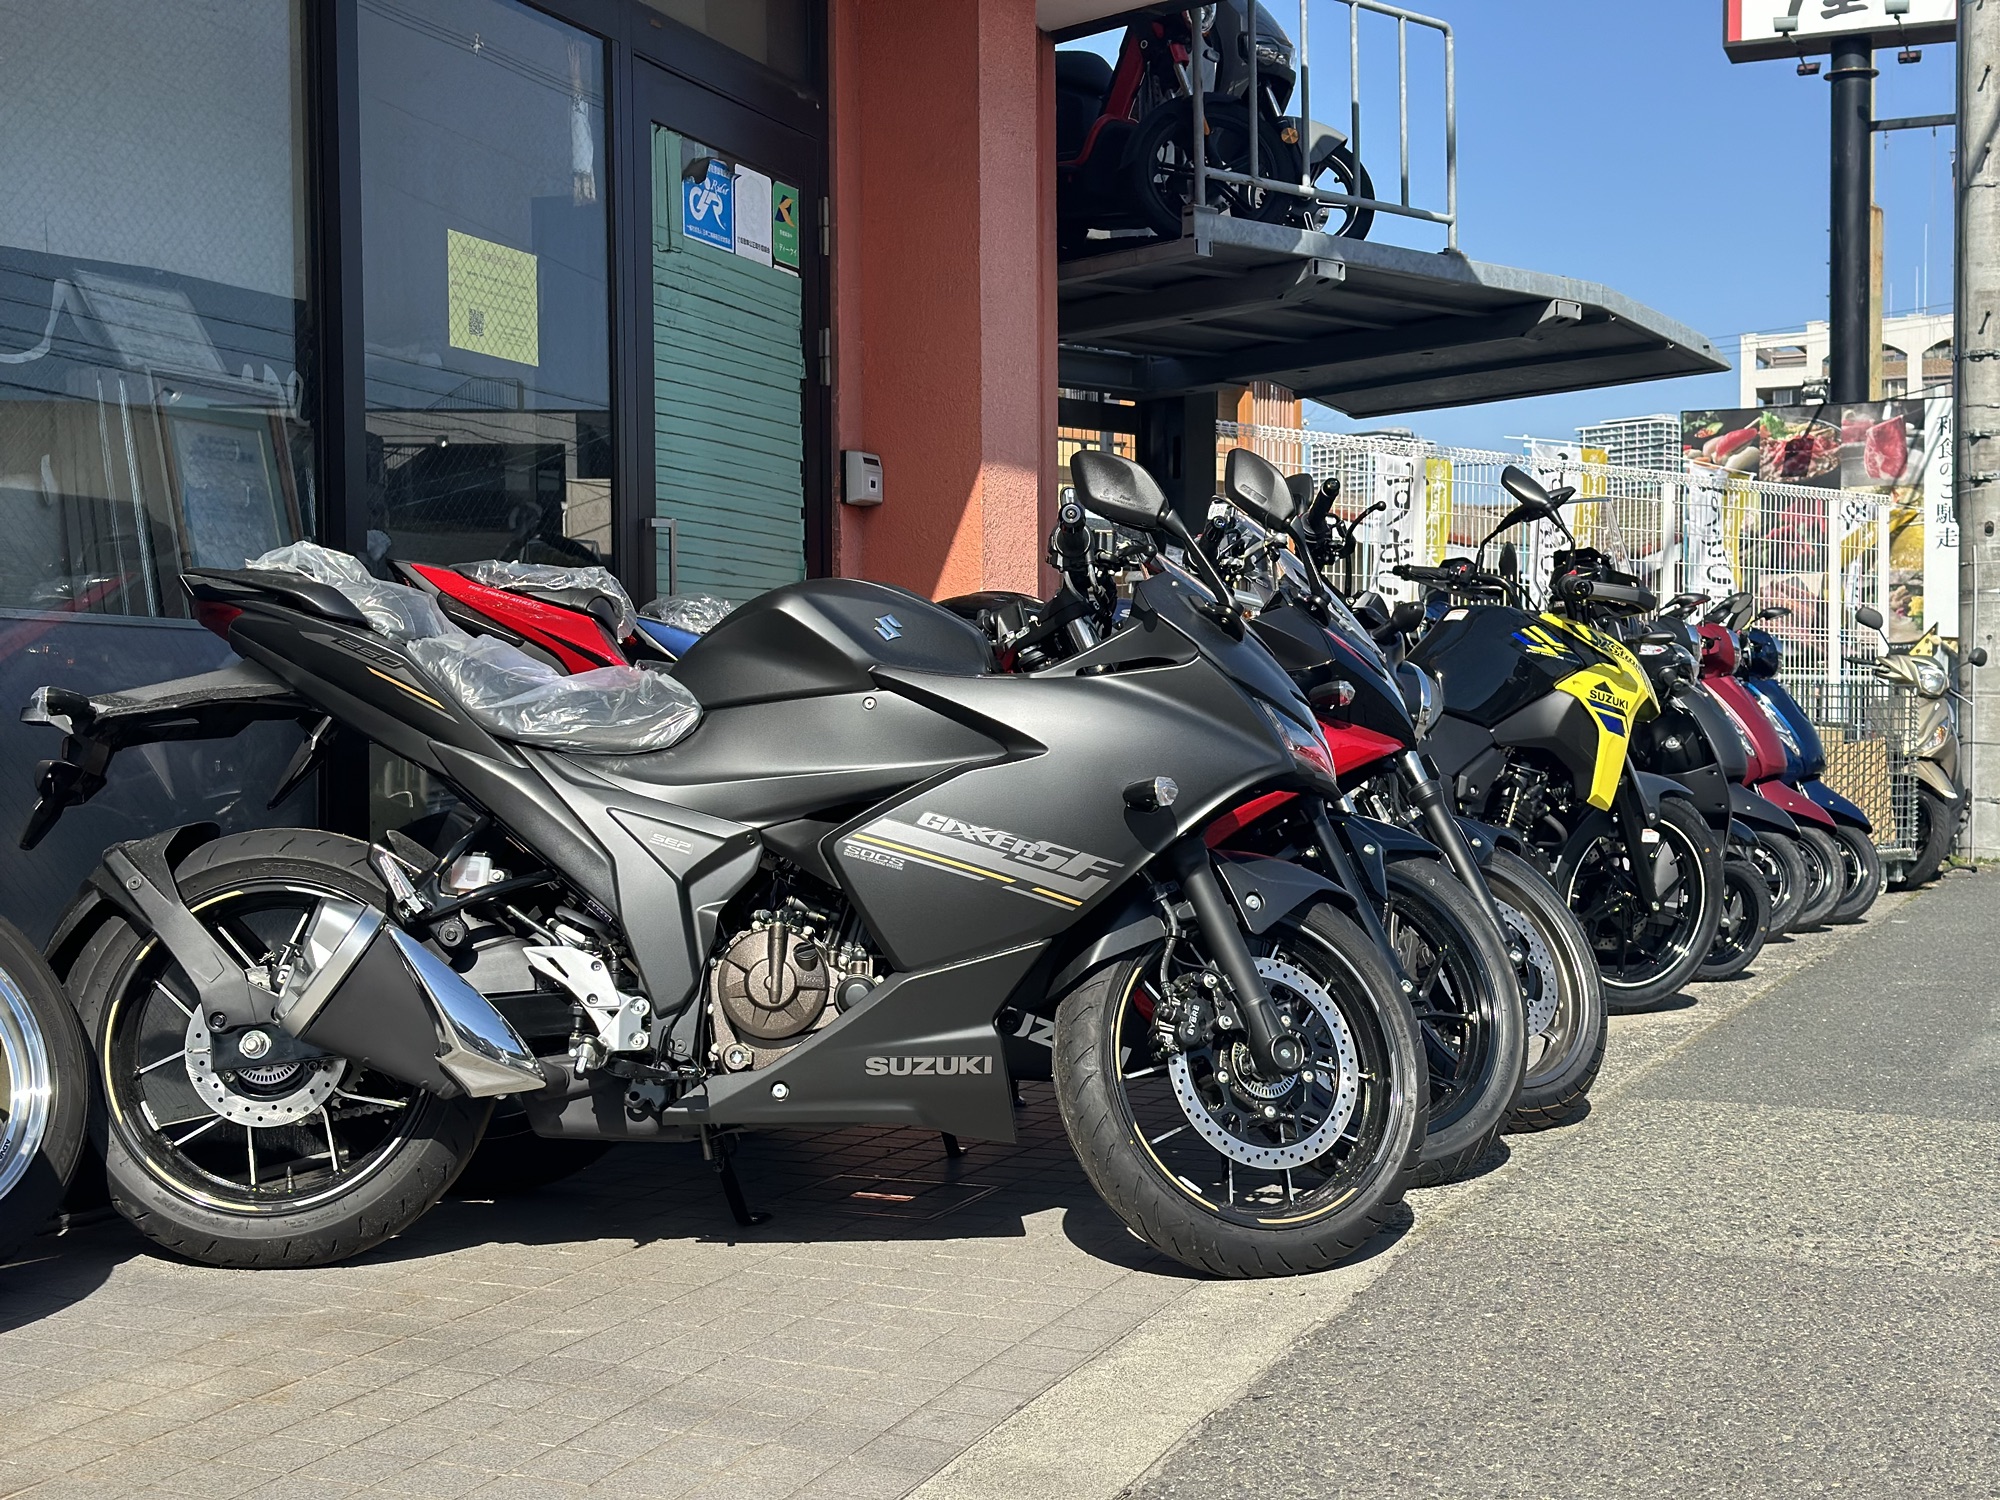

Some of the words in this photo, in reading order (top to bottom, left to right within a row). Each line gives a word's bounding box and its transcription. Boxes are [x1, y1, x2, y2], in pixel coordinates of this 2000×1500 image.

[337, 638, 404, 668] 250
[1589, 689, 1629, 710] SUZUKI
[650, 833, 692, 849] SEP
[916, 811, 1043, 858] GIXXER
[844, 845, 905, 867] SOCS
[864, 1055, 992, 1076] SUZUKI
